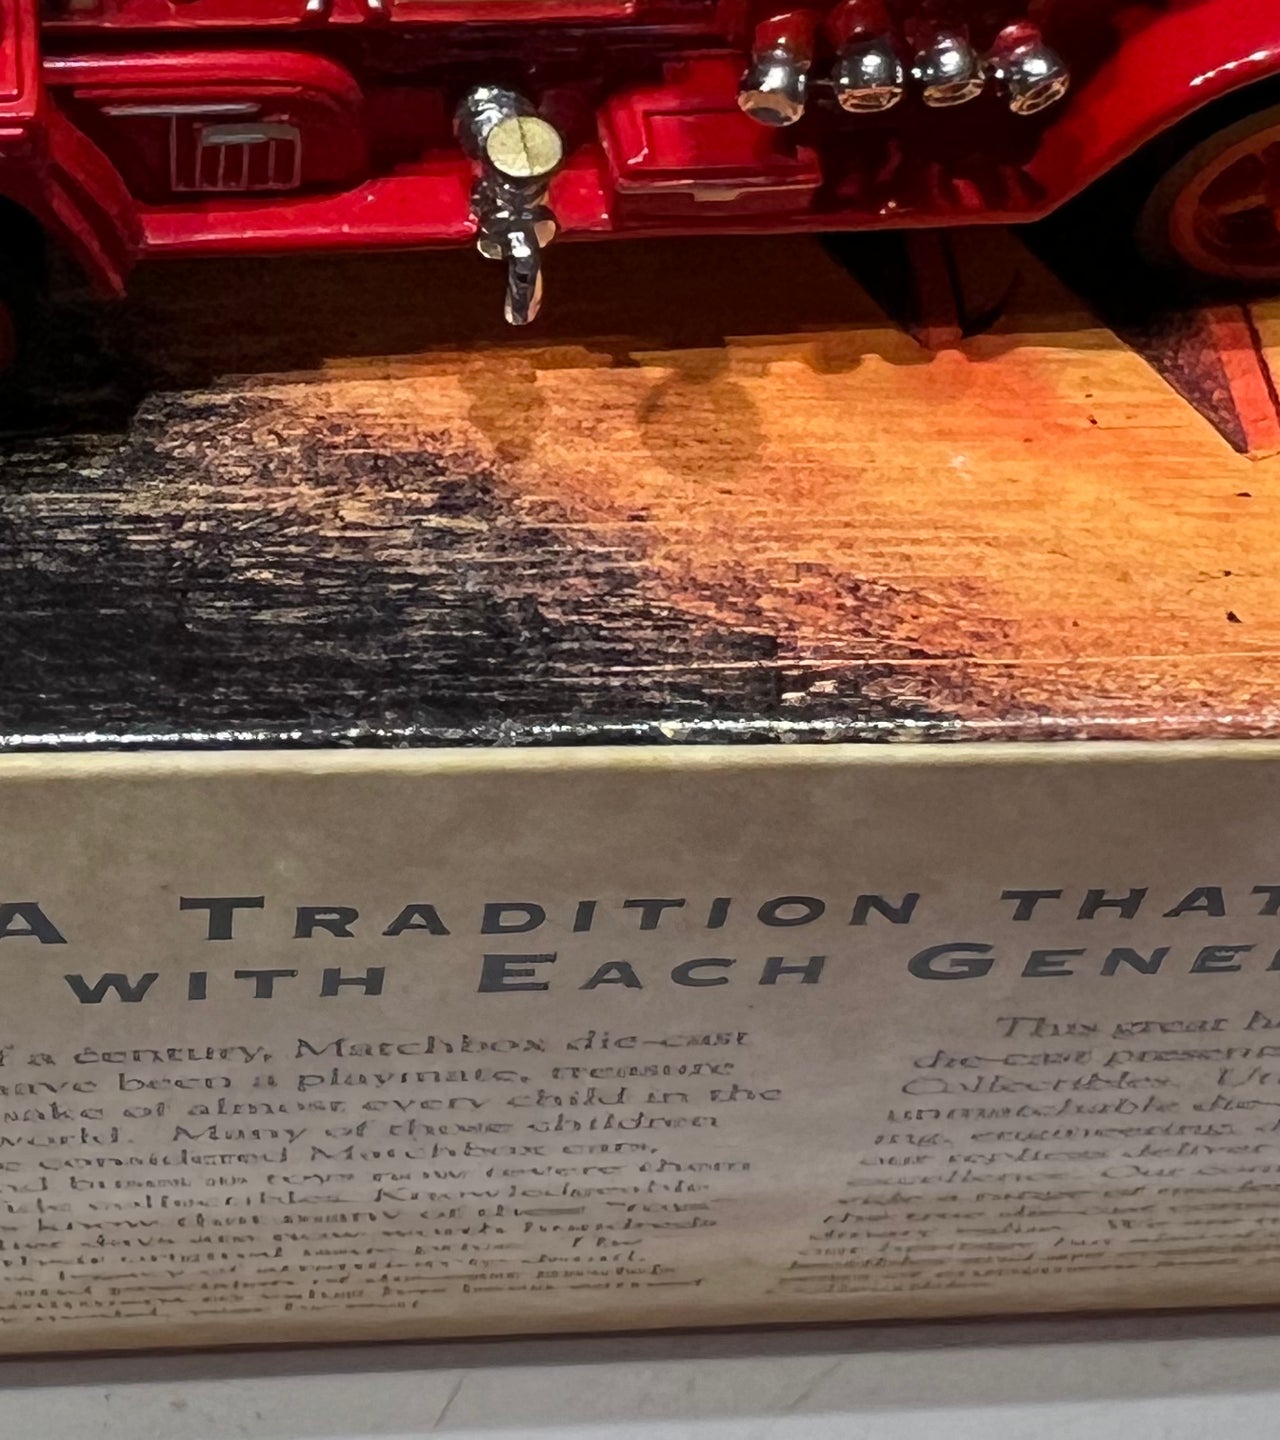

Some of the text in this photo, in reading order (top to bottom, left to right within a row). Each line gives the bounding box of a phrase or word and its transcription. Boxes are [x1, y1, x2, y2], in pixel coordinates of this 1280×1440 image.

[178, 892, 920, 942] TRADITION
[63, 966, 388, 1005] WITH
[475, 950, 829, 996] EACH
